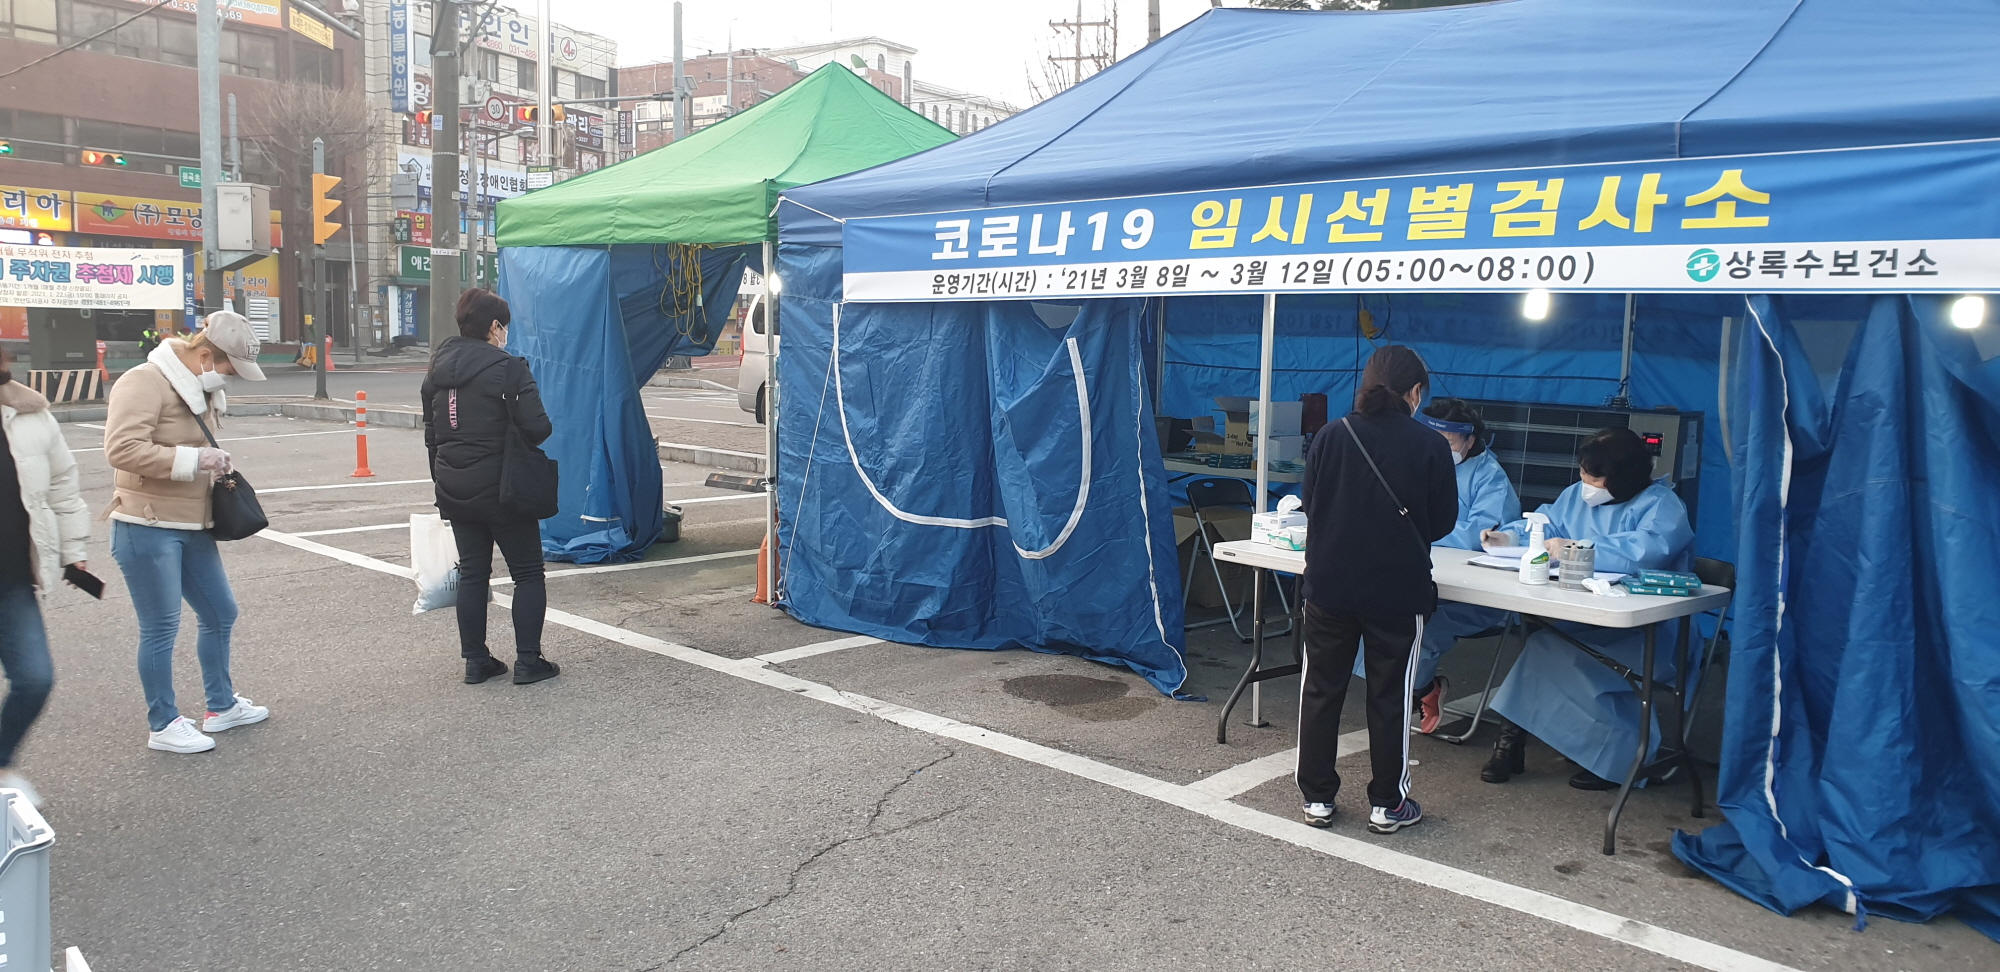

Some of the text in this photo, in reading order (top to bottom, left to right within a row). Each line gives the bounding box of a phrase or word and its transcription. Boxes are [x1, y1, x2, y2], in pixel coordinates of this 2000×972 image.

[491, 104, 500, 114] 30
[182, 172, 201, 182] 원곡초
[931, 168, 1770, 261] 코로나19 임시선별검사소
[18, 247, 48, 257] 무작위
[51, 250, 71, 259] 전자
[74, 251, 94, 260] 추첨
[1725, 248, 1940, 279] 상록수보건소
[10, 259, 174, 285] 주차권 추첨제 시행
[932, 268, 1037, 296] 운영기간(시간)
[1116, 264, 1149, 289] 3월
[1156, 263, 1190, 288] 8일
[1230, 260, 1268, 286] 3월
